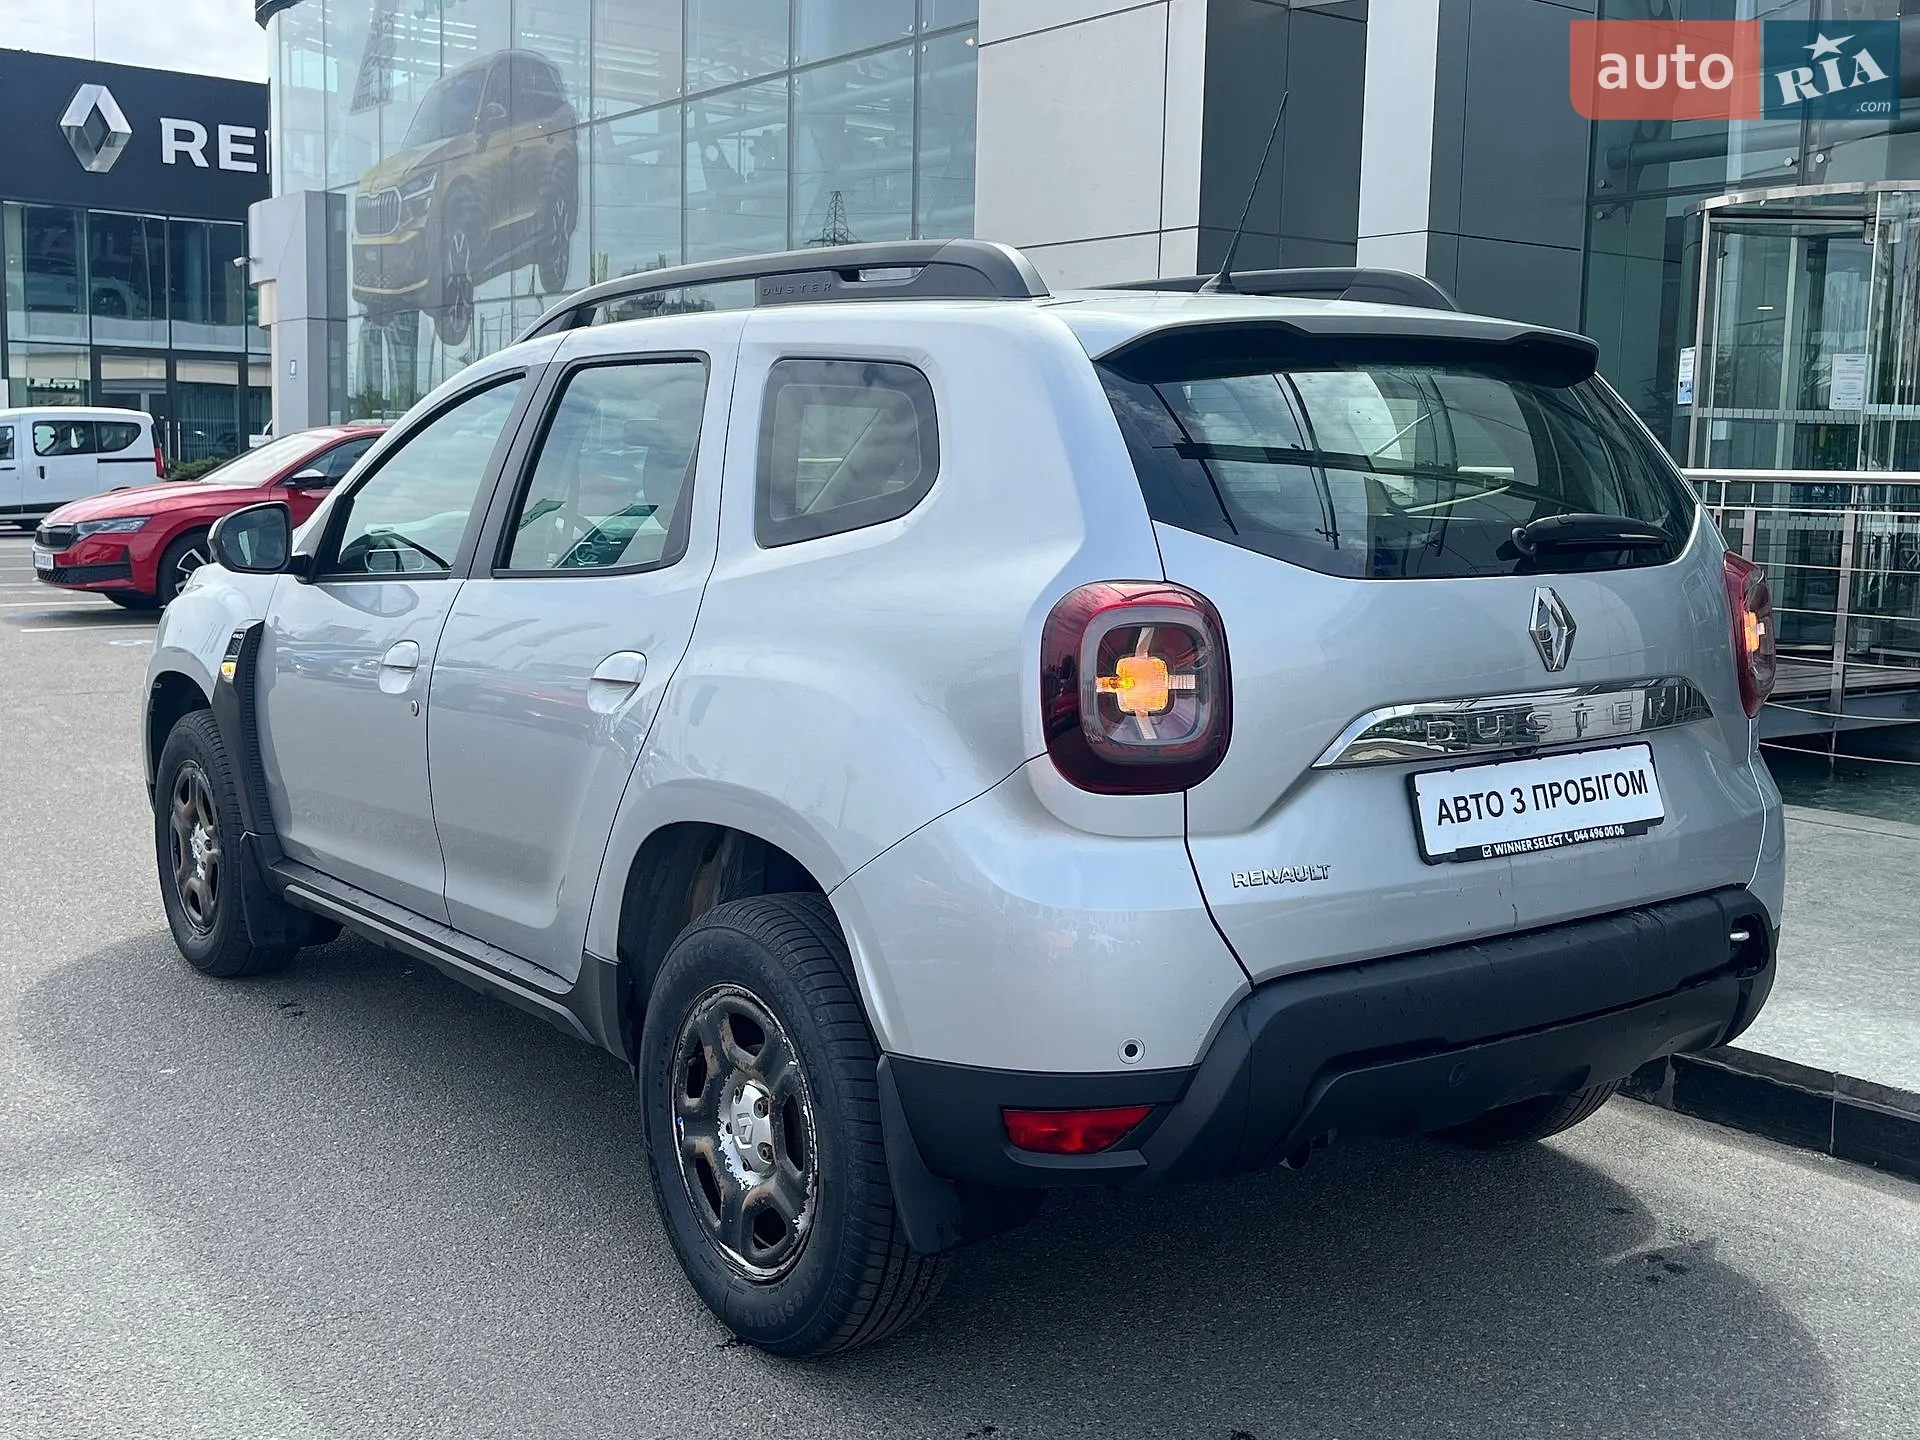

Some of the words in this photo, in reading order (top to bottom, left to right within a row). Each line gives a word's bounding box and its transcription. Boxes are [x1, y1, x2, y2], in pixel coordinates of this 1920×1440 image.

[160, 117, 270, 175] RE
[762, 281, 832, 297] DUSTER
[1426, 697, 1667, 745] DUSTER
[1437, 790, 1504, 826] АВТО
[1532, 769, 1649, 811] ПРОБІГОМ
[1494, 840, 1535, 855] WINNER
[1534, 834, 1564, 850] SELECT
[1574, 829, 1589, 842] 044
[1590, 827, 1605, 839] 496
[1604, 826, 1615, 837] 00
[1615, 824, 1625, 836] 06
[1231, 864, 1331, 888] RENAULT
